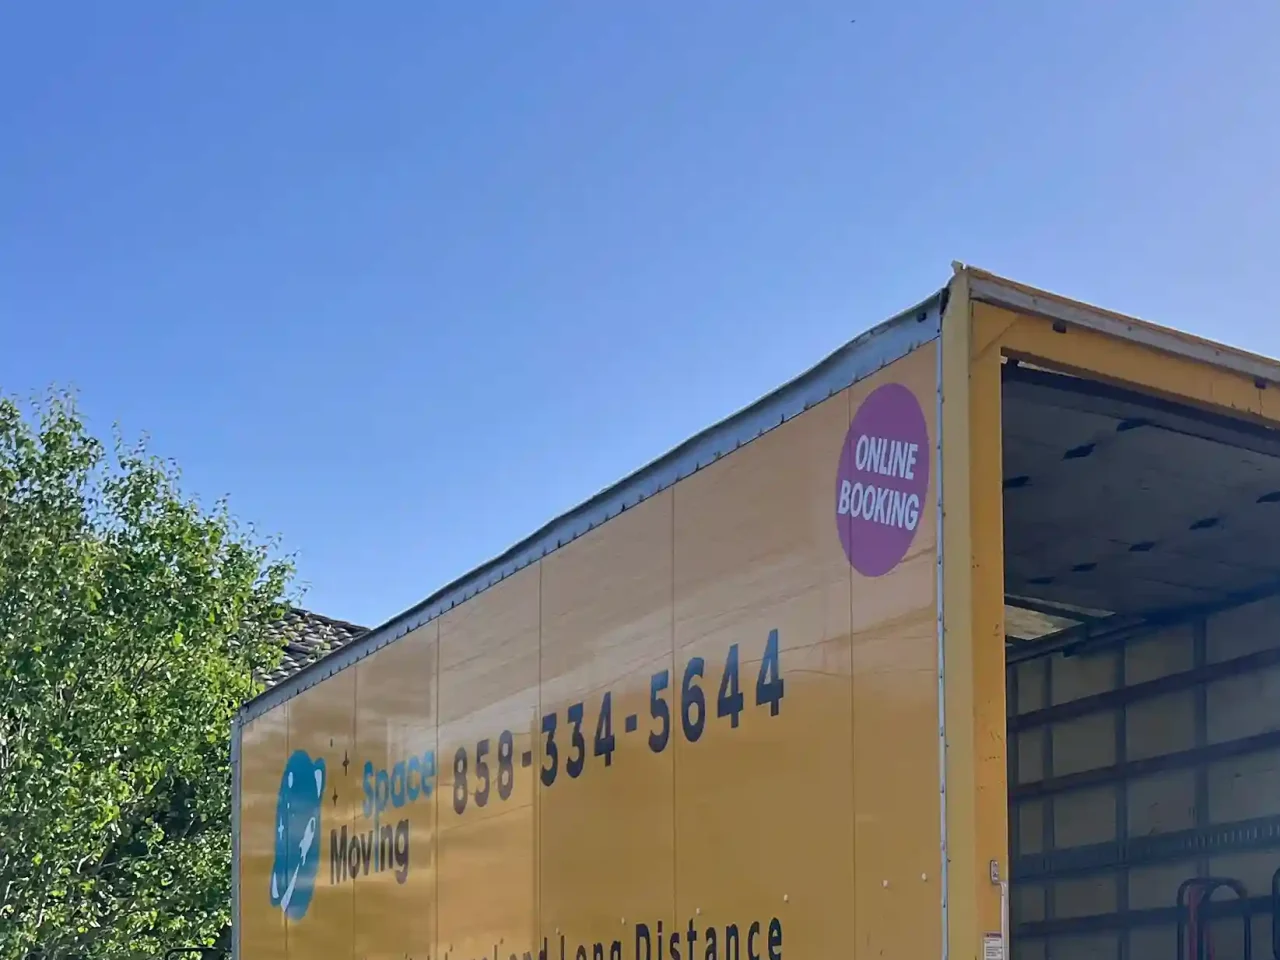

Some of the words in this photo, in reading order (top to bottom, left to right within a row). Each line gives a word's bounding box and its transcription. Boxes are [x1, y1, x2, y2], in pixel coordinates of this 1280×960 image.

[855, 434, 919, 480] ONLINE
[838, 480, 919, 530] BOOKING
[453, 628, 785, 815] 858-334-5644
[363, 750, 436, 819] Space
[330, 818, 409, 885] Moving
